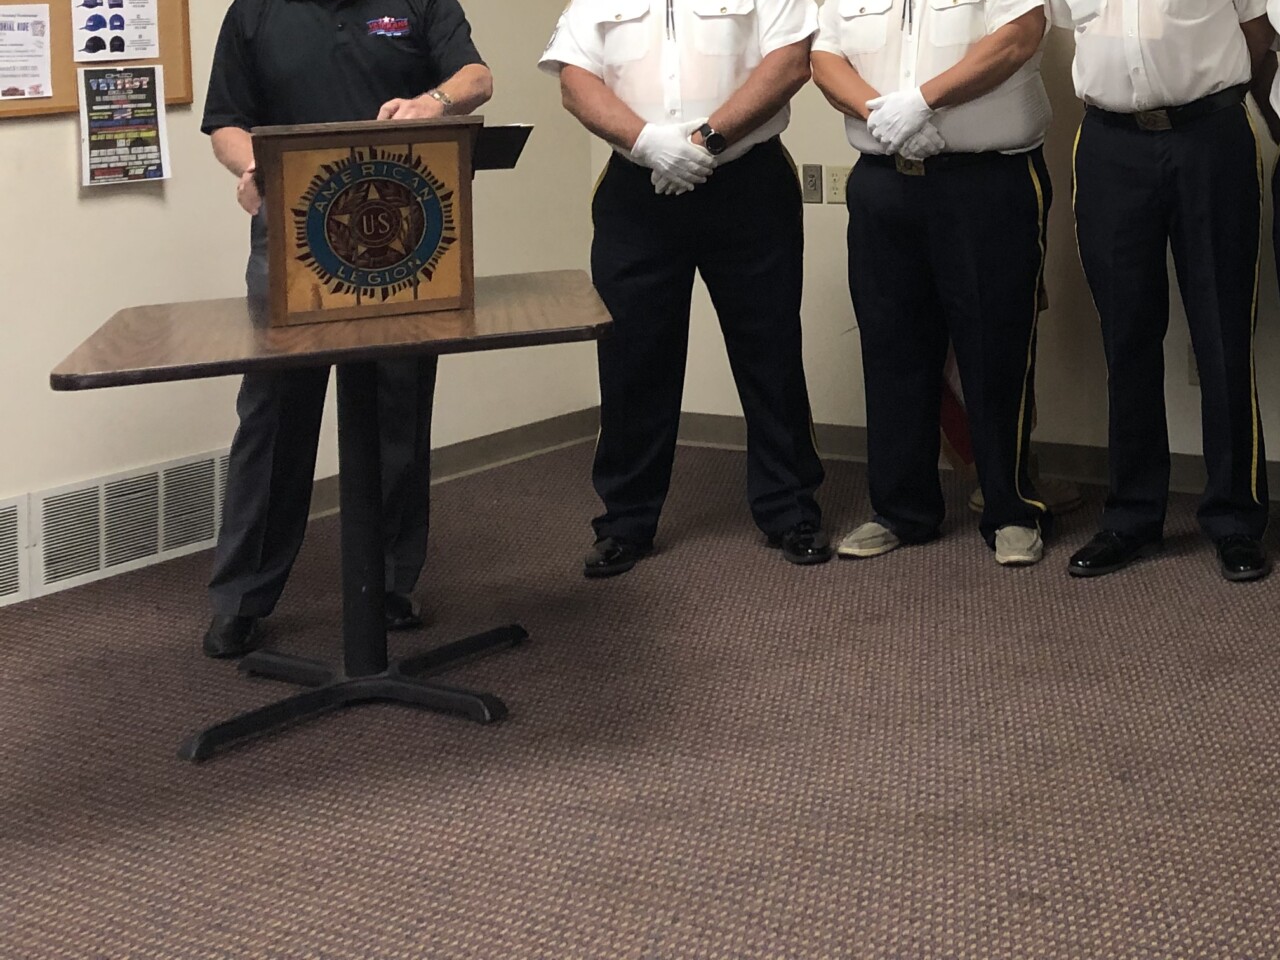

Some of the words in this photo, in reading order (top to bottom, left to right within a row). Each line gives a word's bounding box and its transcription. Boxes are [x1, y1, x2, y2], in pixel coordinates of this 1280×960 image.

[314, 164, 433, 214] AMERICAN
[362, 212, 390, 235] US
[336, 257, 422, 284] LEGION
